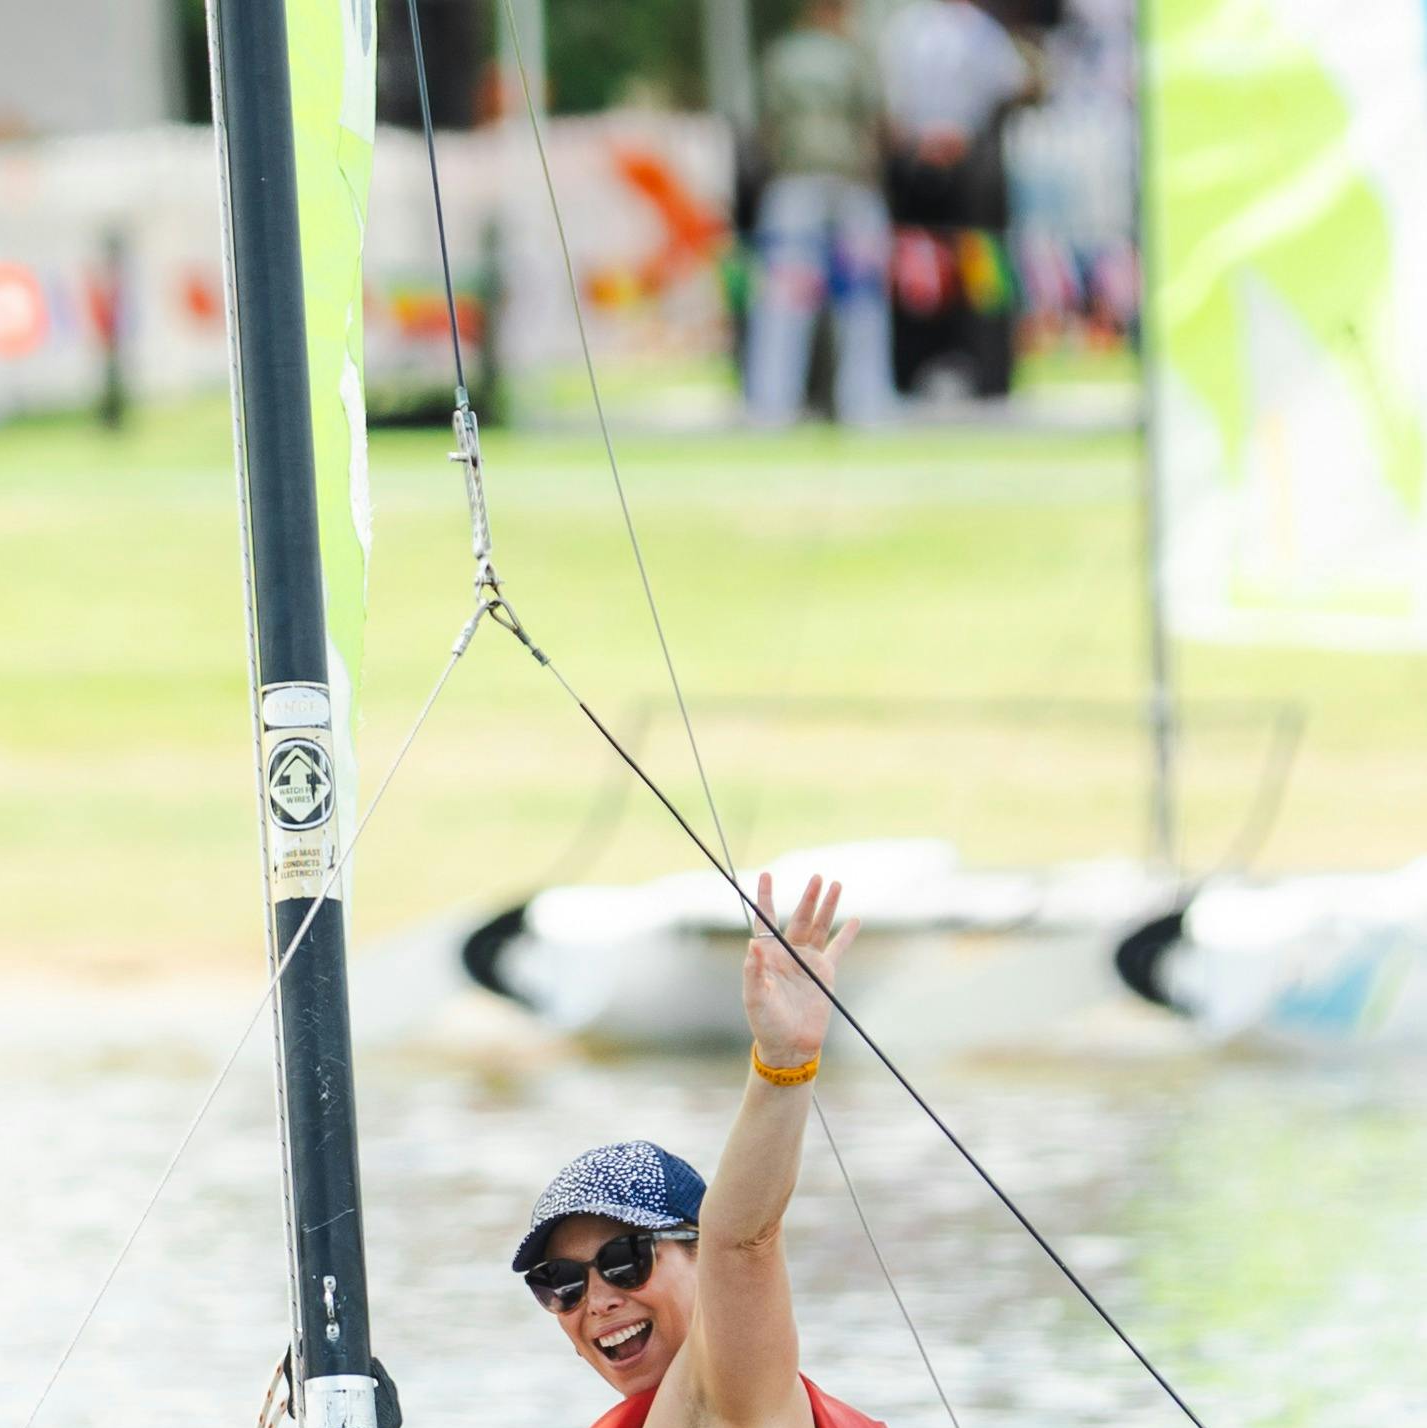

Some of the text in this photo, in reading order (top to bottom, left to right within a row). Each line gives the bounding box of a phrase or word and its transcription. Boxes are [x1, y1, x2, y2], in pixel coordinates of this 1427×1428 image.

[279, 786, 304, 796] WATCH
[286, 795, 311, 804] WIRES
[299, 848, 320, 857] MAST
[283, 859, 320, 869] CONDUCTS
